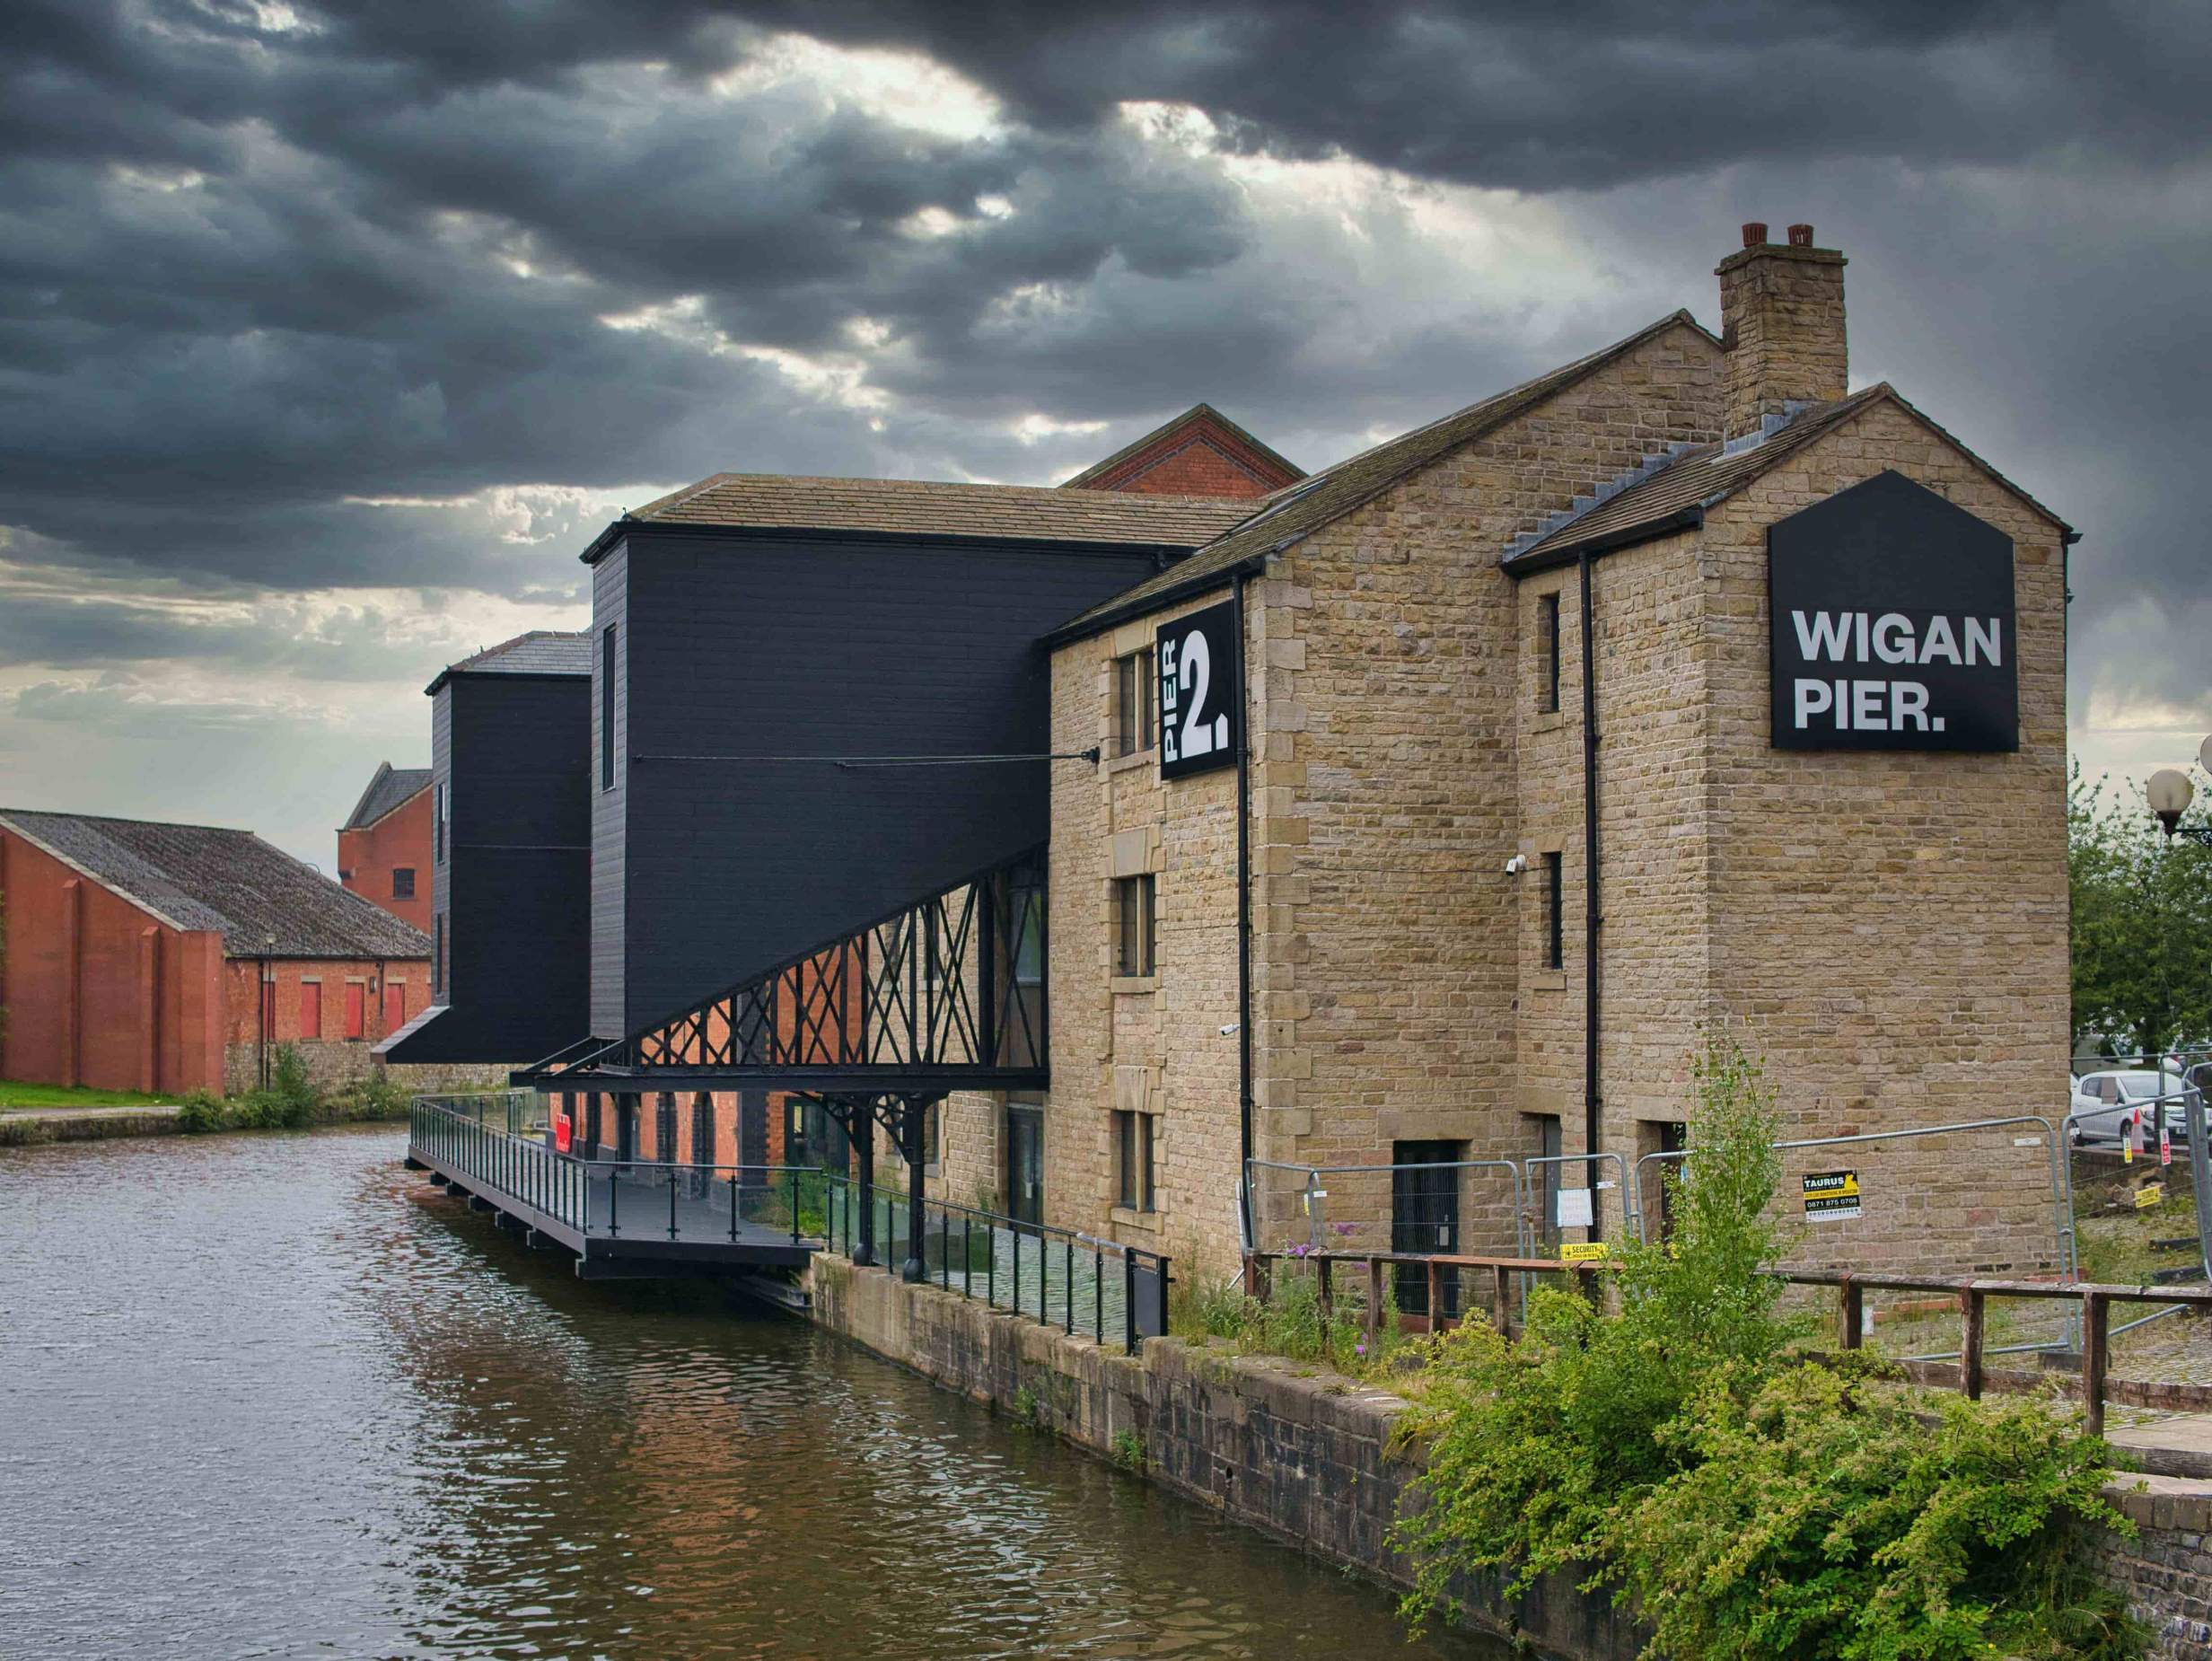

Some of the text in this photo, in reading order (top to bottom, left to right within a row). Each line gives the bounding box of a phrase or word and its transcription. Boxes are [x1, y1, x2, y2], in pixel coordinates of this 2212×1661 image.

[1792, 611, 2001, 666] WIGAN
[1163, 639, 1178, 762] PIER
[1795, 679, 1944, 732] PIER.
[1804, 1177, 1844, 1187] TAURUS
[1573, 1245, 1597, 1253] SECURITY
